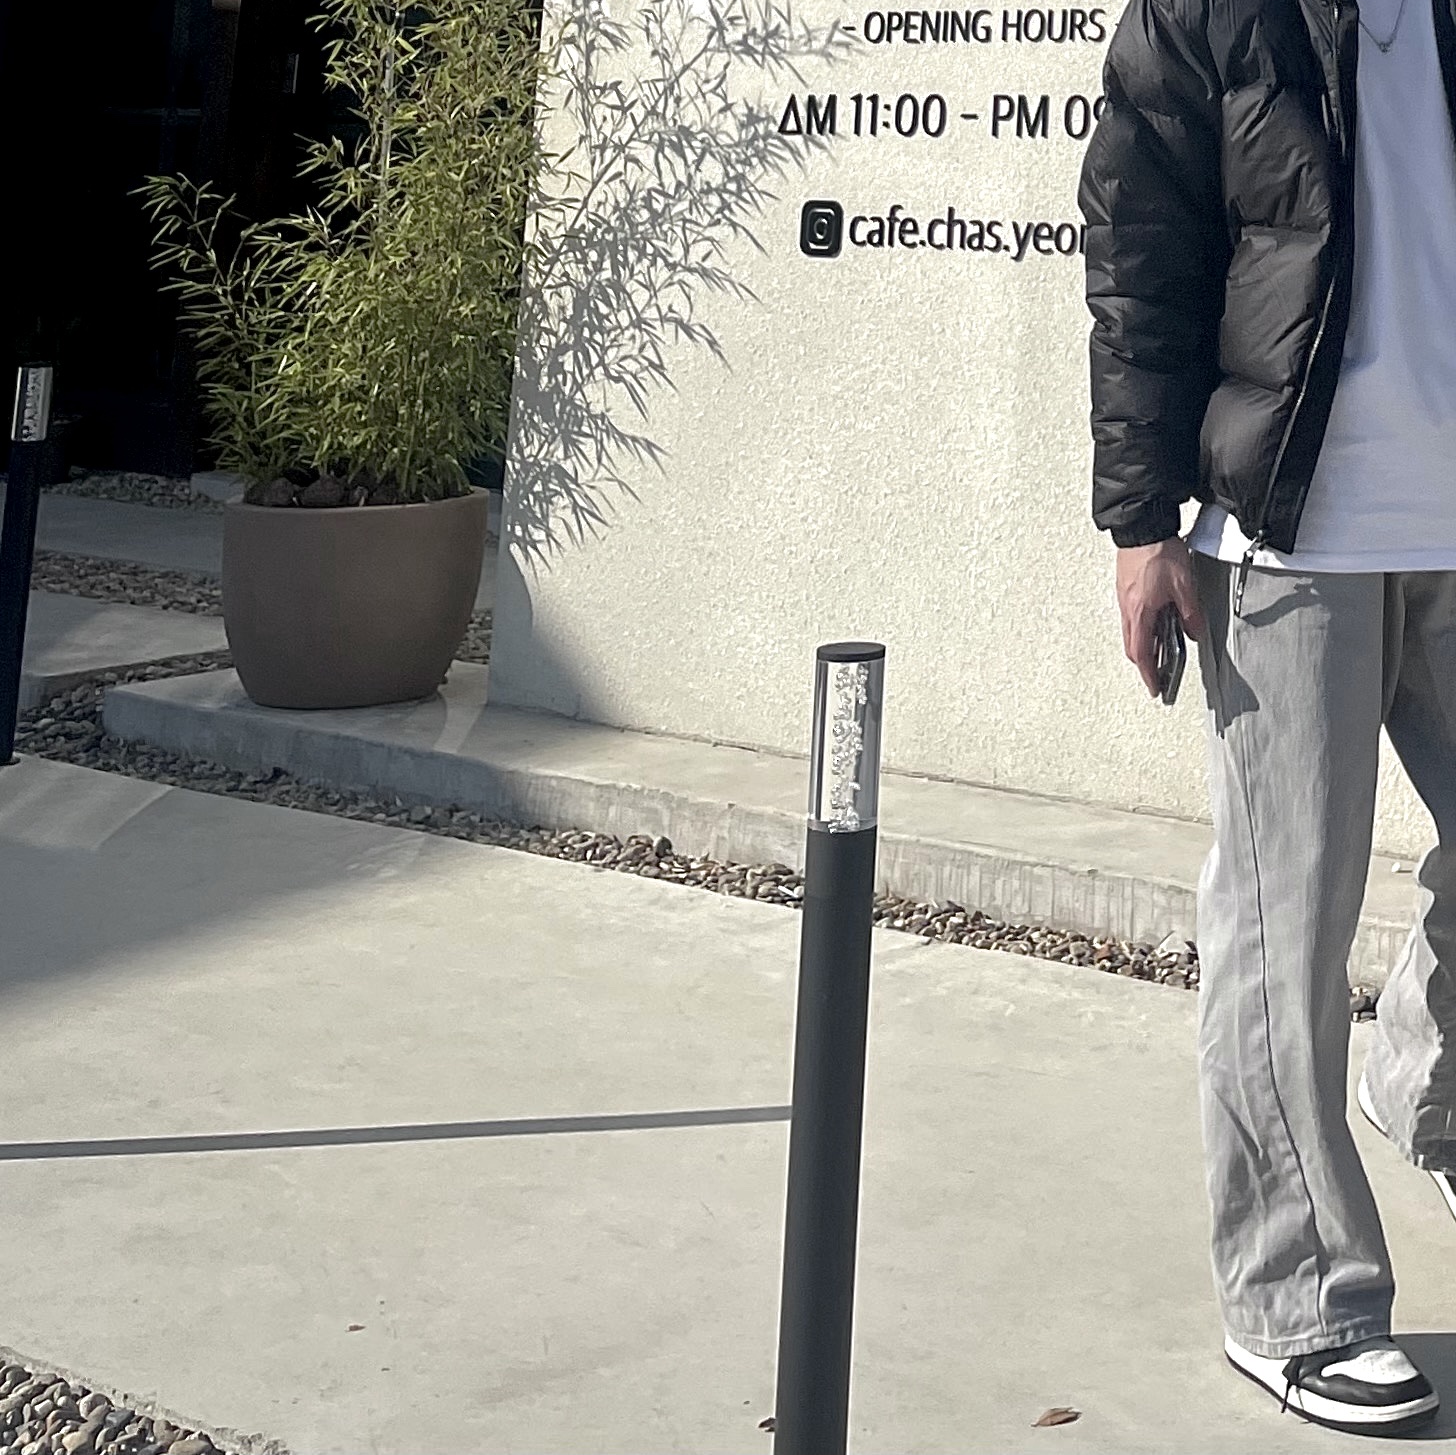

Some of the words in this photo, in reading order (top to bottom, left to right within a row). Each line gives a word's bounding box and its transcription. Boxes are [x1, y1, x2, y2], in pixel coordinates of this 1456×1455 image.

[863, 10, 993, 44] OPENING
[1001, 8, 1107, 44] HOURS
[777, 93, 838, 137] AM
[850, 93, 948, 139] 11:00
[991, 94, 1050, 140] PM
